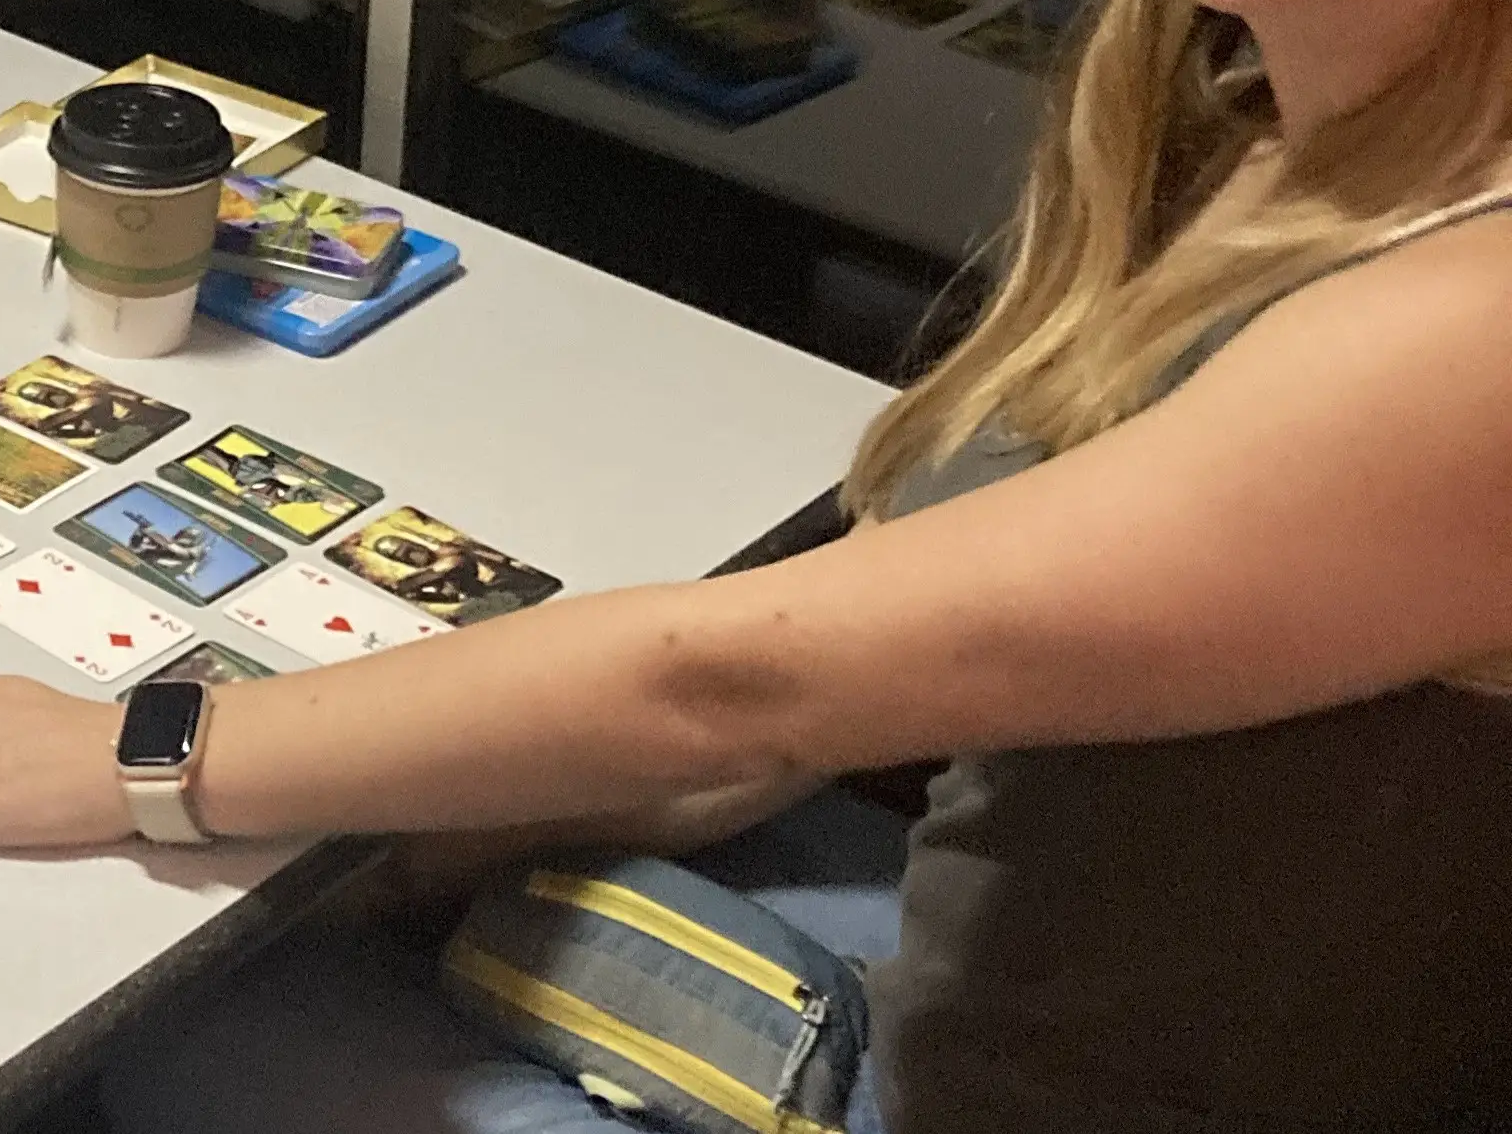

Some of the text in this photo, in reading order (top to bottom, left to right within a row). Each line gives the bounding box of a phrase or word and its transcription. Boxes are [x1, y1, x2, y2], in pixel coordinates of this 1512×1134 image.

[43, 552, 64, 566] 2
[161, 619, 182, 634] 2
[86, 662, 108, 677] 2
